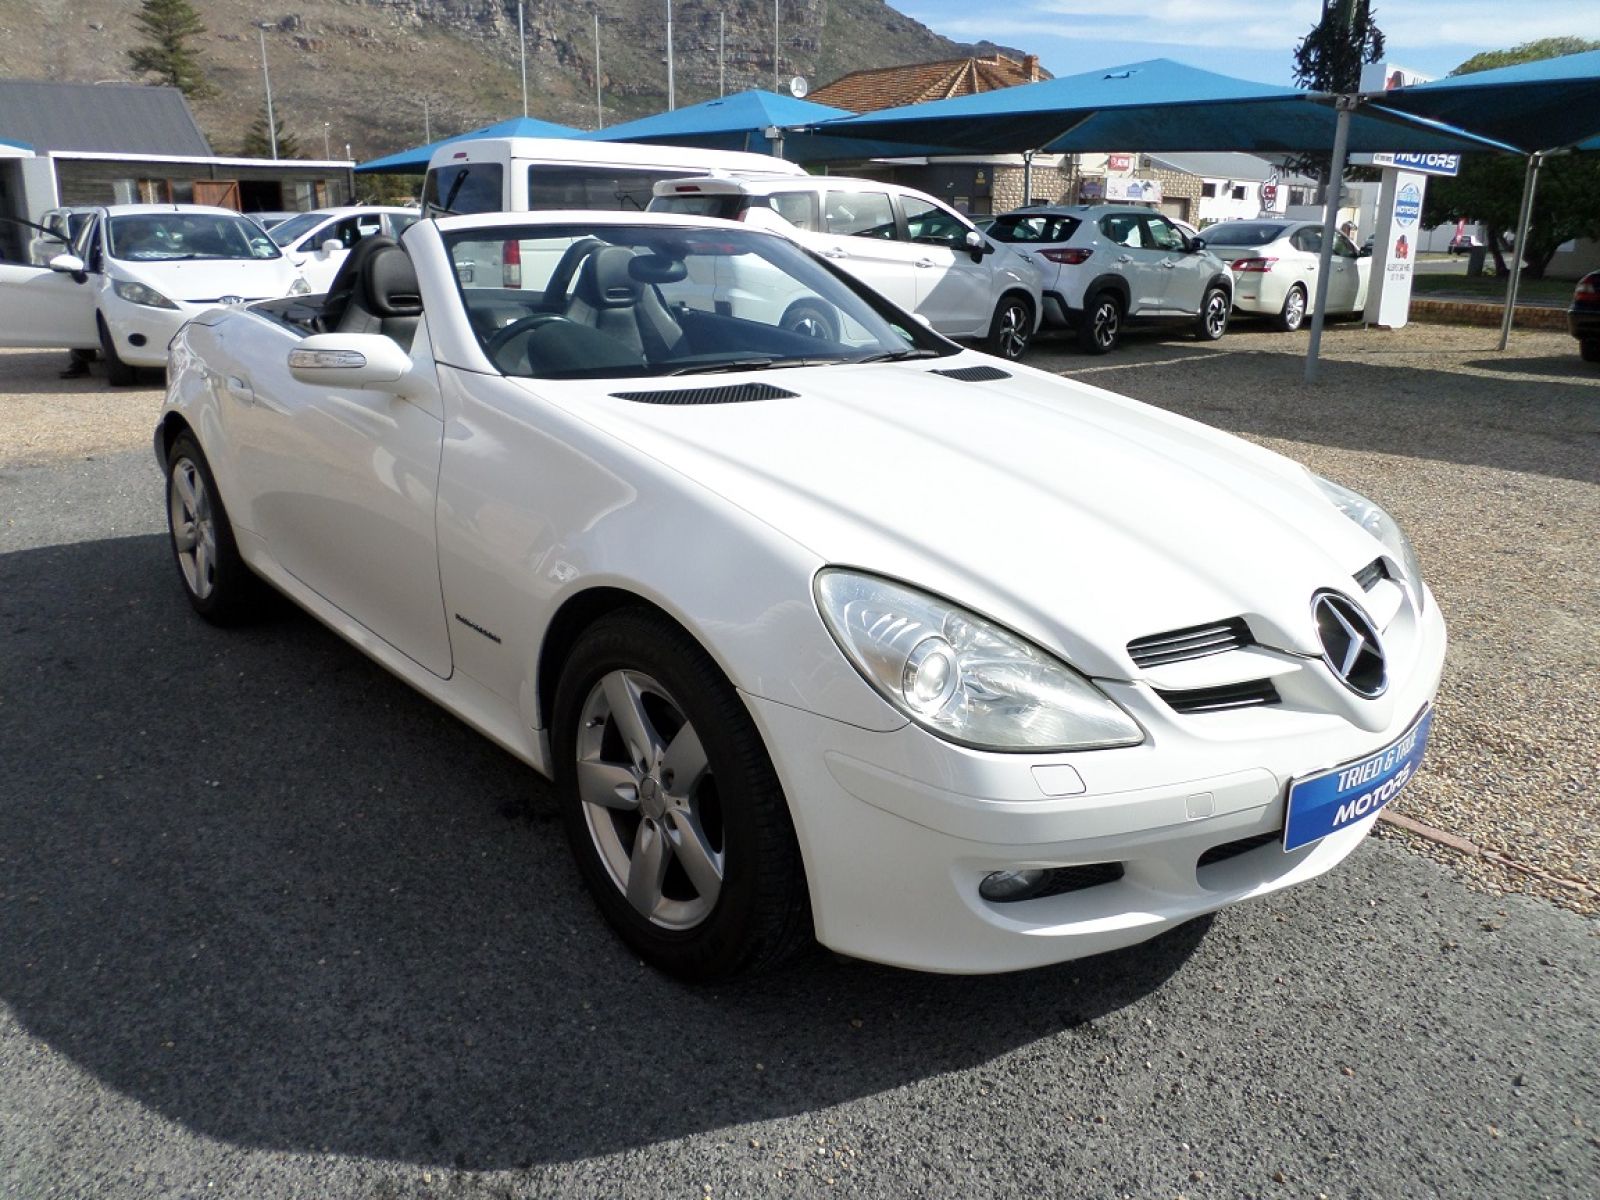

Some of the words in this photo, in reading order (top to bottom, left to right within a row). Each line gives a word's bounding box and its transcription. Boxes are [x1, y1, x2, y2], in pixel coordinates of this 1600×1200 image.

[1396, 153, 1457, 168] MOTORS
[1338, 757, 1382, 792] TRIED
[1385, 750, 1395, 771] &
[1332, 760, 1411, 827] MOTORS
